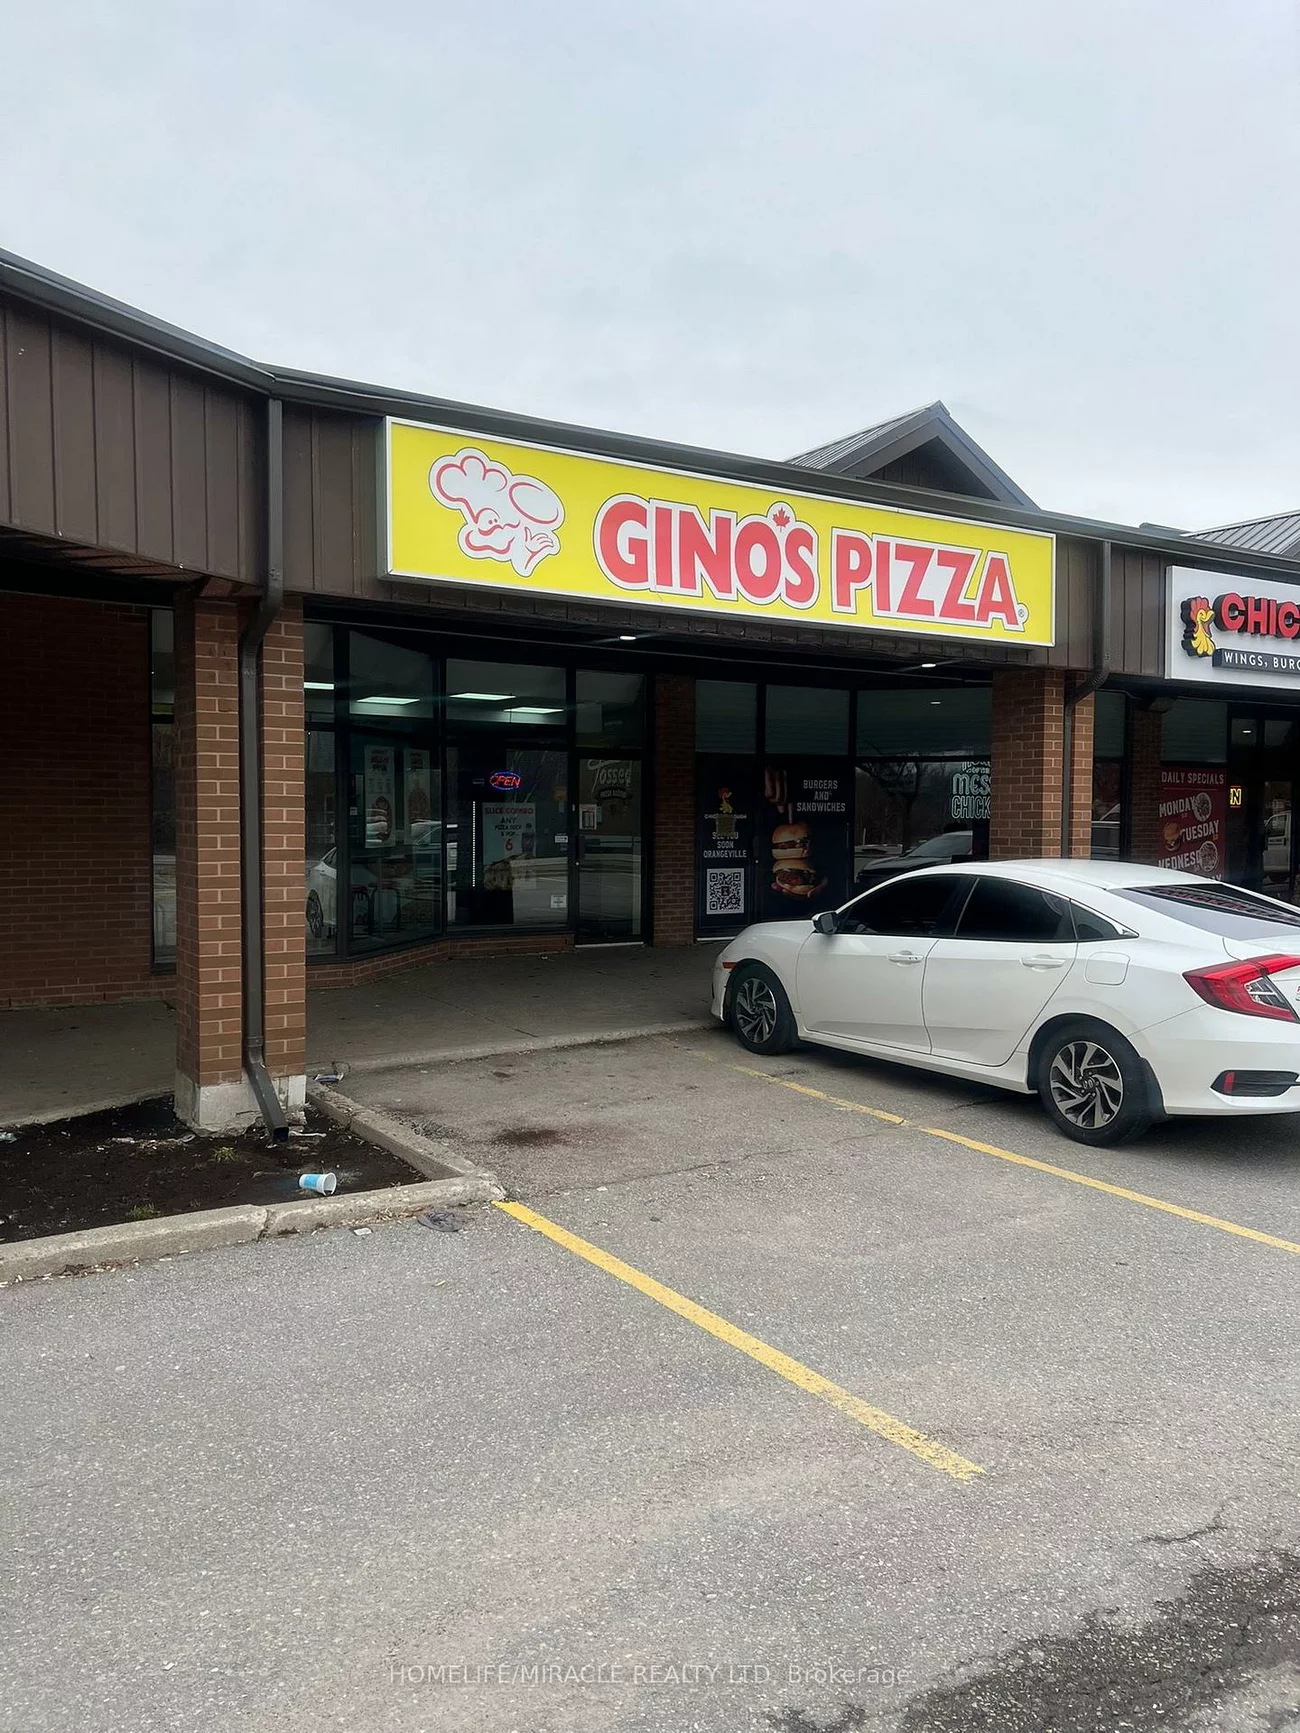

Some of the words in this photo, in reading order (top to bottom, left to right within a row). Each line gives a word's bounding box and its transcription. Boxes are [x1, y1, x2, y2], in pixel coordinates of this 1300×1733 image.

[834, 531, 1021, 628] PIZZA
[1224, 651, 1268, 668] WINGS,
[490, 775, 521, 788] OPEN
[803, 779, 838, 789] BURGERS
[1161, 771, 1185, 783] DAILY
[1187, 773, 1224, 785] SPECIALS
[813, 791, 829, 801] AND
[796, 801, 846, 812] SANDWICHES
[1159, 795, 1196, 818] MONDAY
[1180, 819, 1220, 842] TUESDAY
[716, 841, 734, 849] SOON
[703, 849, 747, 859] ORANGEVILLE
